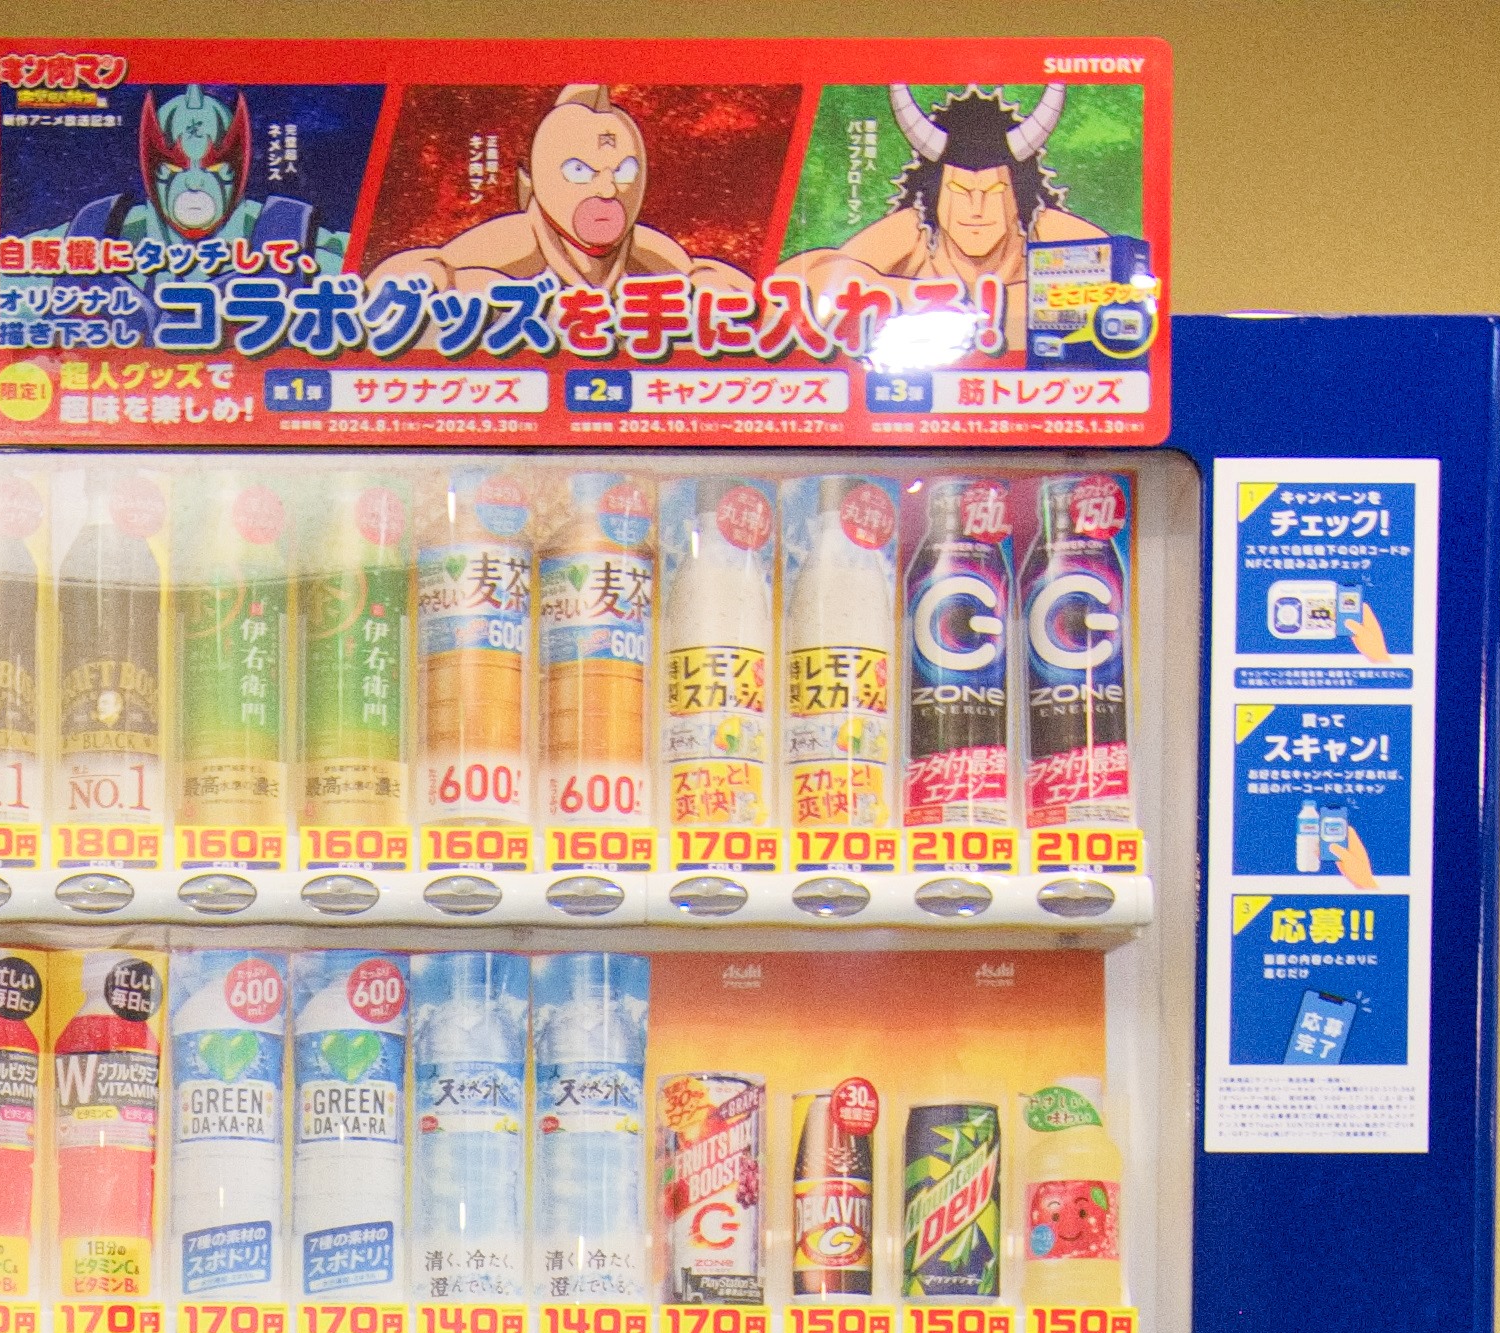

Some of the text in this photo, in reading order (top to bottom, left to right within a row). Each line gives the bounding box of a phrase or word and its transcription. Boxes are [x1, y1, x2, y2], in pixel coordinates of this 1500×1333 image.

[0, 53, 128, 88] キン肉マン
[1043, 56, 1145, 74] SUNTORY
[60, 361, 234, 391] 超人グッズで
[352, 376, 520, 405] サウナグッズ
[646, 376, 830, 405] キャンプグッズ
[957, 376, 1122, 405] 筋トレグッズ
[60, 393, 255, 424] 趣味を楽しめ!
[1280, 490, 1383, 505] キャンペーンを
[1270, 509, 1390, 537] チェック!
[468, 551, 530, 611] 麦茶
[241, 617, 267, 726] 伊右衛門
[684, 654, 750, 680] レモン
[806, 654, 872, 680] レモン
[1302, 713, 1346, 728] 買って
[1263, 734, 1389, 762] スキャン!
[673, 763, 750, 793] スカッと!
[58, 829, 160, 857] 180円
[181, 829, 282, 859] 160円
[308, 830, 408, 859] 160円
[677, 831, 778, 861] 170円
[798, 831, 896, 861] 170円
[912, 831, 1014, 861] 210円
[1037, 832, 1139, 861] 210円
[1271, 907, 1375, 944] 応募!!
[114, 967, 156, 989] 忙しい
[1294, 1033, 1337, 1060] 完了
[56, 1054, 98, 1106] W
[434, 1077, 508, 1107] 天然水
[190, 1087, 264, 1117] GREEN
[313, 1088, 386, 1117] GREEN
[688, 1152, 744, 1203] BOOST
[188, 1243, 269, 1275] スポドリ!
[424, 1249, 515, 1272] 清く、冷たく、
[430, 1275, 510, 1298] 澄んでいる。
[62, 1306, 160, 1333] 170円
